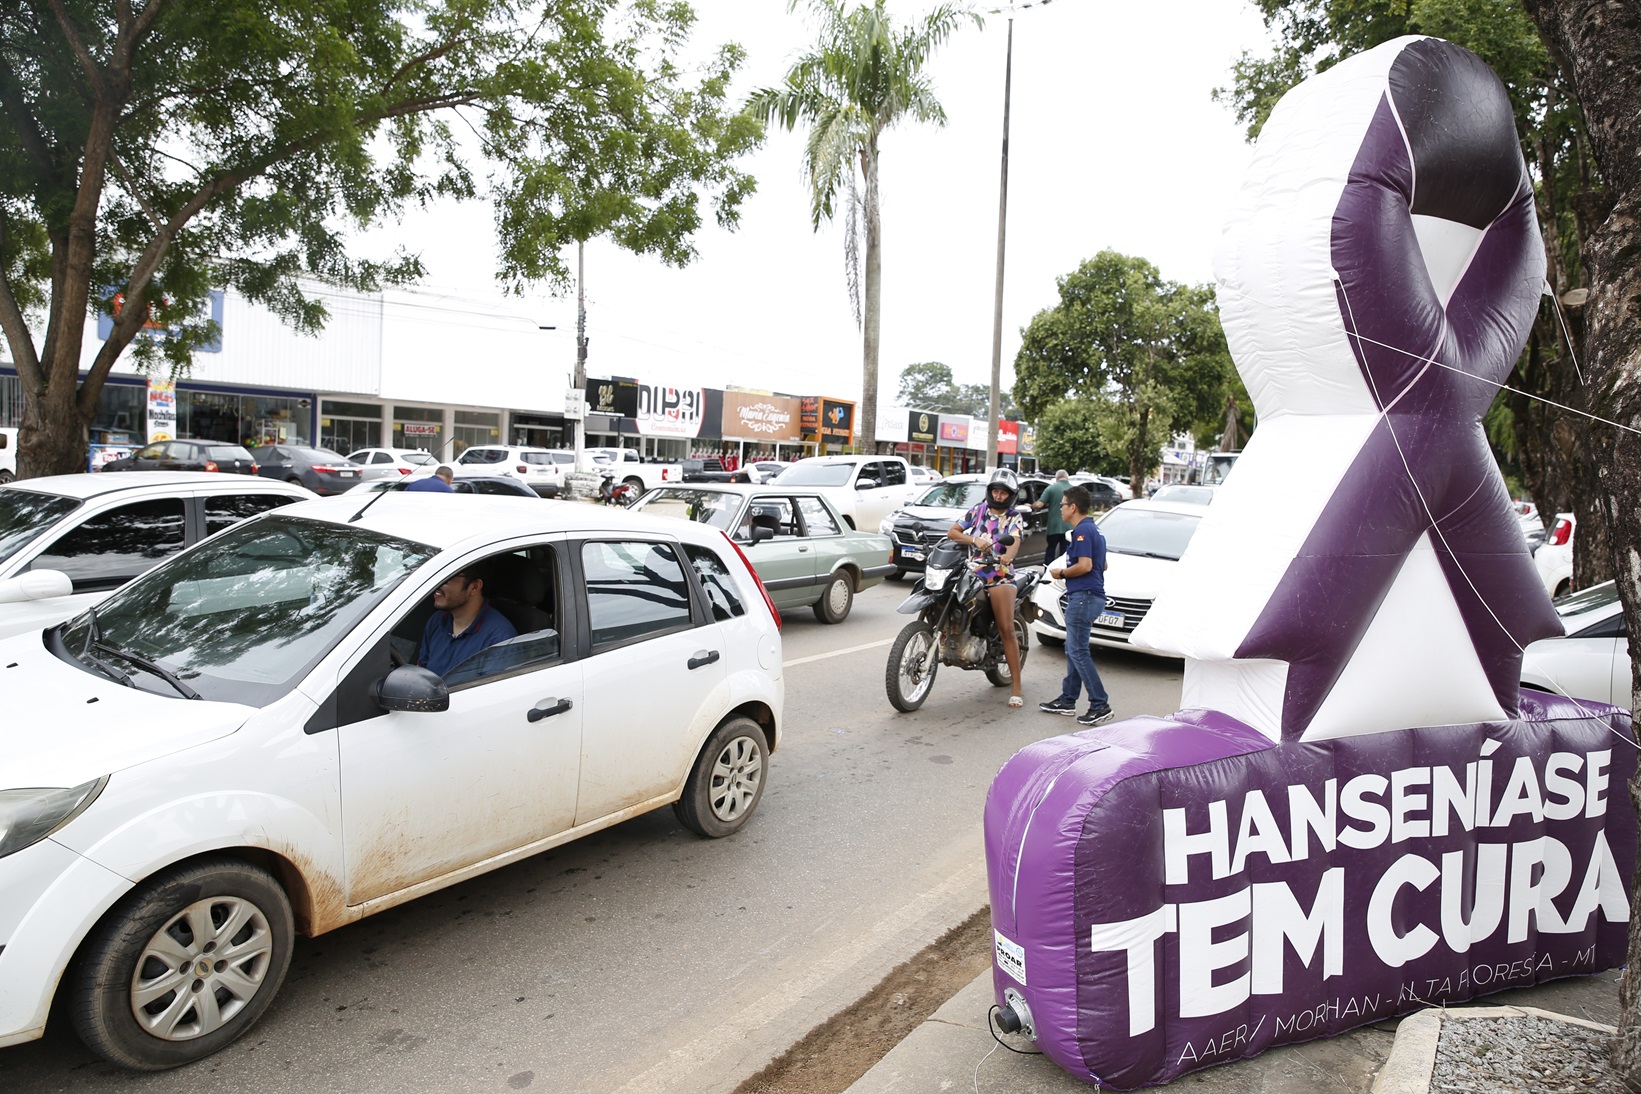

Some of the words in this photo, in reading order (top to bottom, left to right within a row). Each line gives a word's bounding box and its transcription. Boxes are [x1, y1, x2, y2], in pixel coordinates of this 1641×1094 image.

[638, 385, 700, 424] DUBAI
[1163, 739, 1612, 885] HANSENÍASE
[1091, 867, 1344, 1037] TEM
[1367, 828, 1629, 968] CURA
[1274, 993, 1380, 1038] MORHAN
